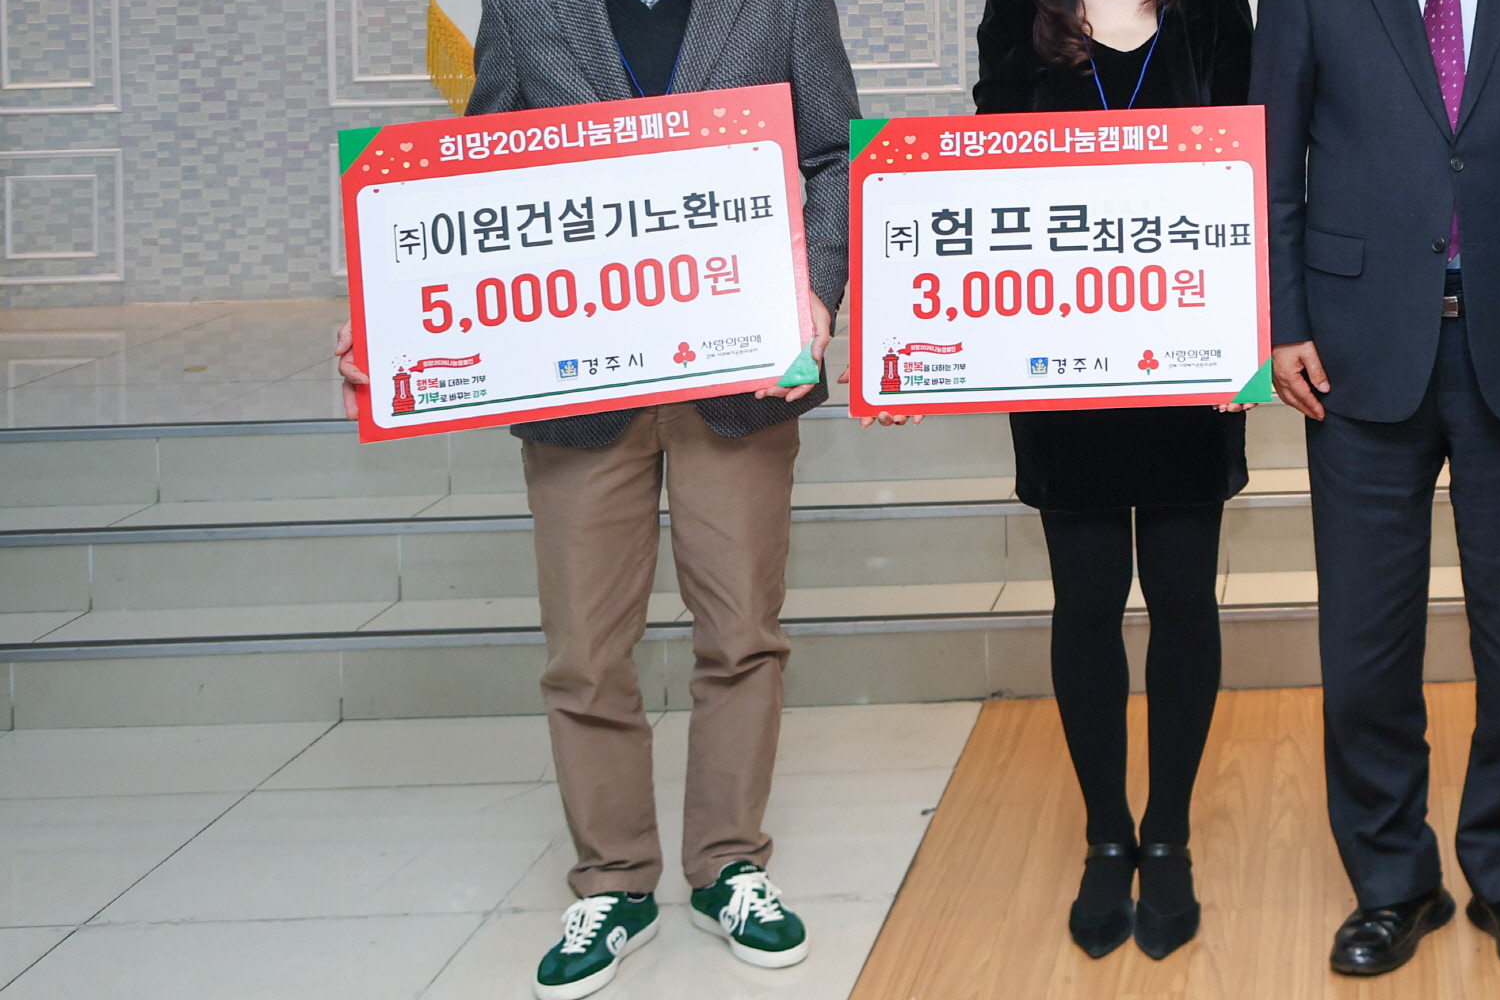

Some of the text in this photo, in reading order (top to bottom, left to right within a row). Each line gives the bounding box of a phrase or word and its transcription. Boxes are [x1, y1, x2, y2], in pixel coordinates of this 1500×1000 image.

[439, 110, 690, 161] 희망2026나눔캠페인
[940, 125, 1168, 156] 희망2026나눔캠페인
[422, 255, 740, 333] 5,000,000원
[913, 265, 1205, 322] 3,000,000원
[701, 334, 762, 355] 사랑의열매
[1164, 349, 1222, 363] 사랑의열매
[581, 352, 644, 376] 경주시
[1051, 357, 1108, 375] 경주시
